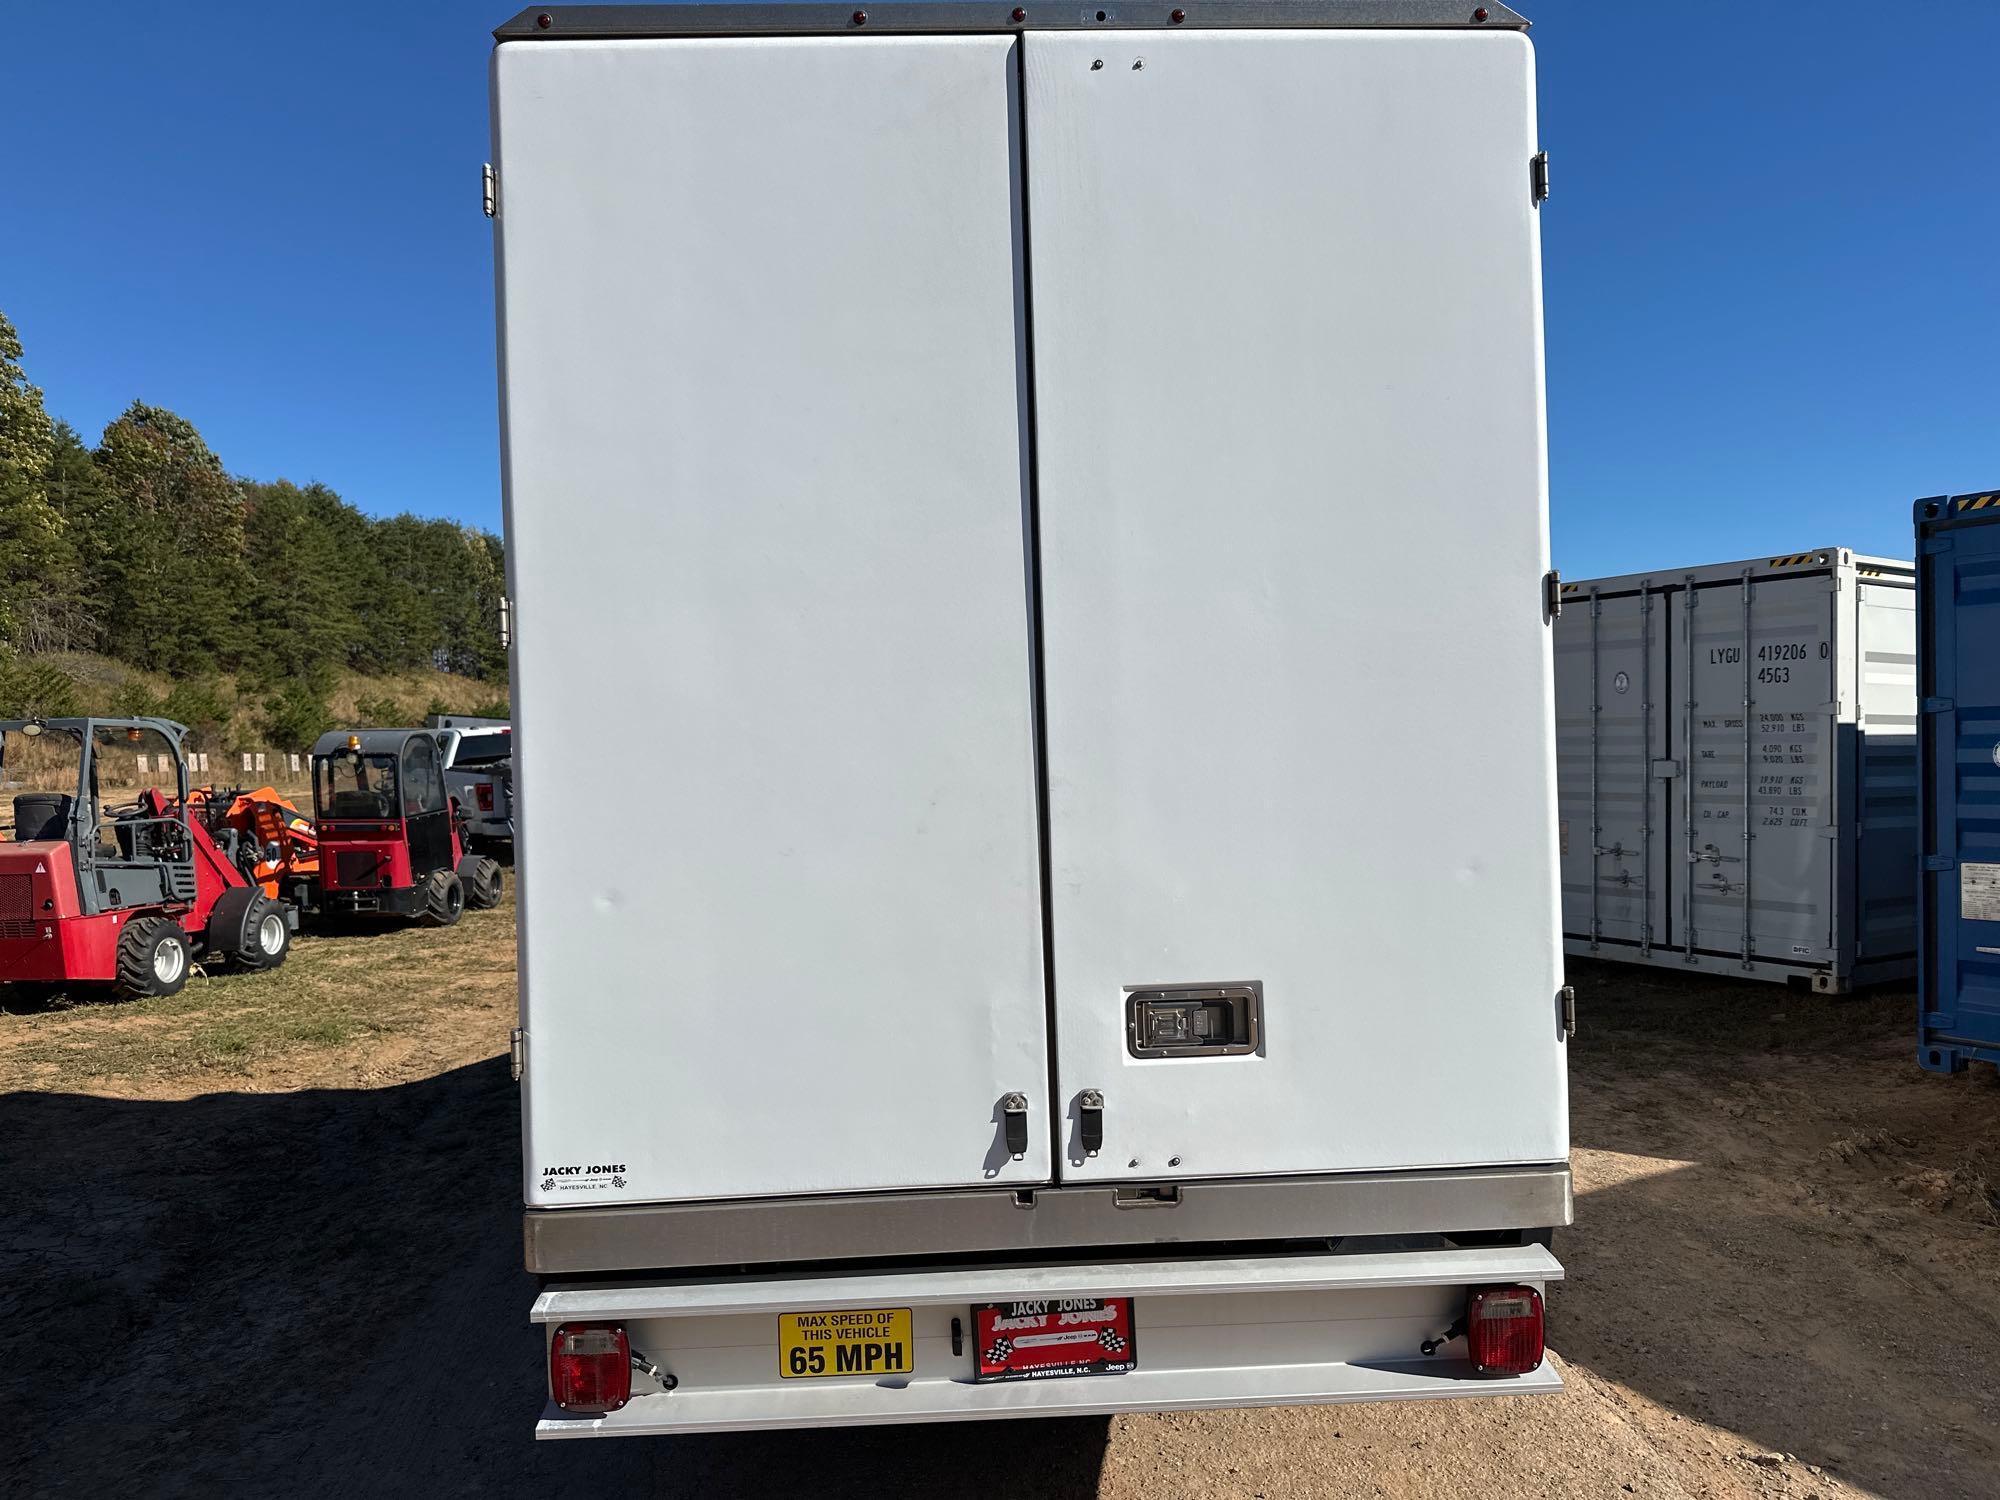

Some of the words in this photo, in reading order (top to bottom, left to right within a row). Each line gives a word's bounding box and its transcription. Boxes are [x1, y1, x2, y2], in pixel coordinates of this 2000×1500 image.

[1710, 647, 1740, 665] LYGU
[1758, 644, 1807, 662] 419206
[1820, 642, 1829, 659] 0
[1758, 667, 1790, 684] 45G3
[1790, 713, 1805, 721] KGS
[1724, 719, 1744, 728] GROSS
[1792, 723, 1805, 732] LBS
[1789, 744, 1803, 753] KGS
[1790, 755, 1805, 764] LBS
[1701, 780, 1729, 789] PAYLOAD
[1790, 776, 1804, 785] KGS
[1789, 786, 1802, 796] LBS
[1769, 806, 1784, 816] 74.3
[266, 847, 277, 862] 50
[542, 1166, 581, 1176] JACKY
[585, 1164, 626, 1174] JONES
[1011, 1300, 1049, 1316] JACKY
[1057, 1299, 1097, 1312] JONES
[797, 1315, 828, 1327] MAX
[831, 1313, 873, 1326] SPEED
[877, 1312, 895, 1324] OF
[991, 1314, 1048, 1332] JACKY
[1058, 1304, 1118, 1326] JONES
[801, 1328, 832, 1341] THIS
[835, 1326, 891, 1339] VEHICLE
[789, 1345, 825, 1375] 65
[836, 1342, 903, 1372] MPH
[1031, 1367, 1076, 1379] HAYESVILLE,
[1105, 1363, 1125, 1372] Jeep
